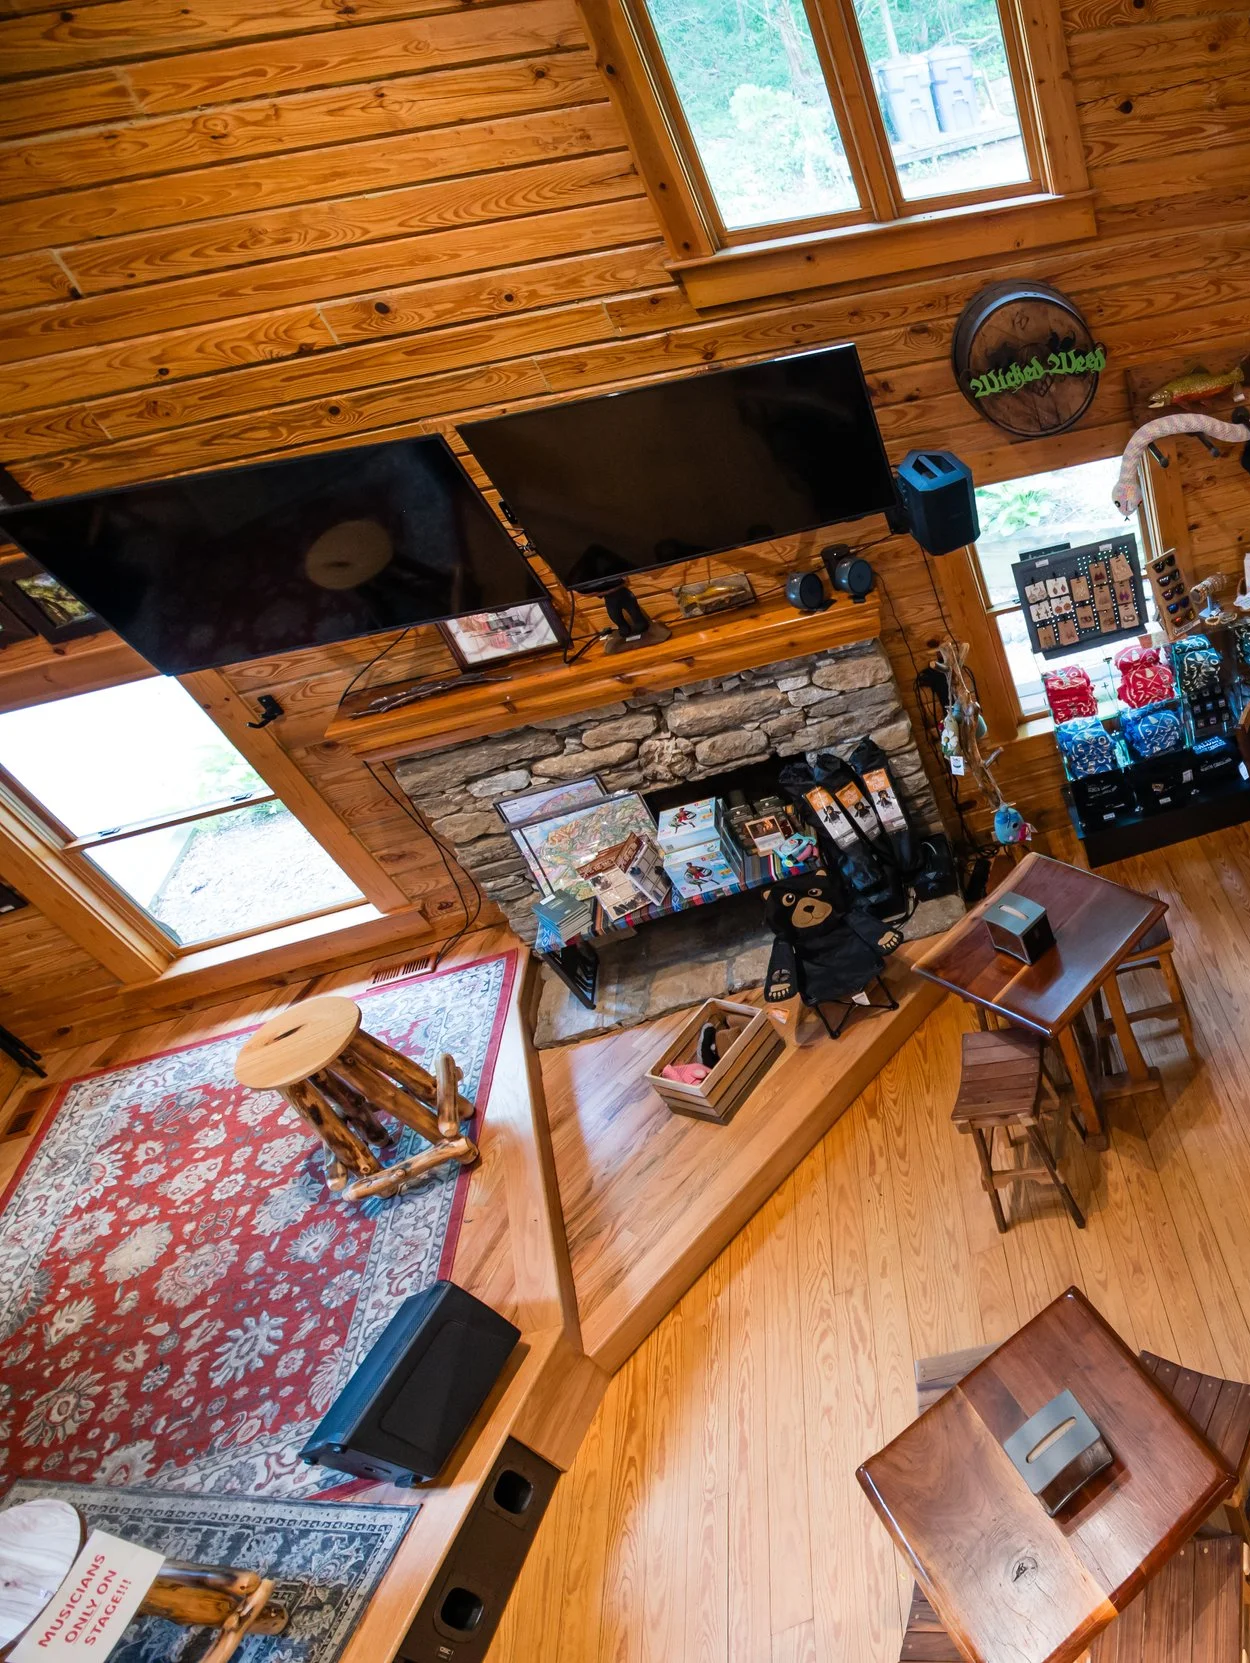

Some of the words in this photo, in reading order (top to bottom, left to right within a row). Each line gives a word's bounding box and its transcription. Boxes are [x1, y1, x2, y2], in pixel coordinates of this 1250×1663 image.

[970, 356, 1044, 398] Wicked
[1047, 347, 1106, 375] Weed
[38, 1554, 105, 1647] MUSICIANS
[64, 1599, 98, 1643] ONLY
[97, 1570, 117, 1595] ON
[84, 1579, 132, 1646] STAGE!!!
